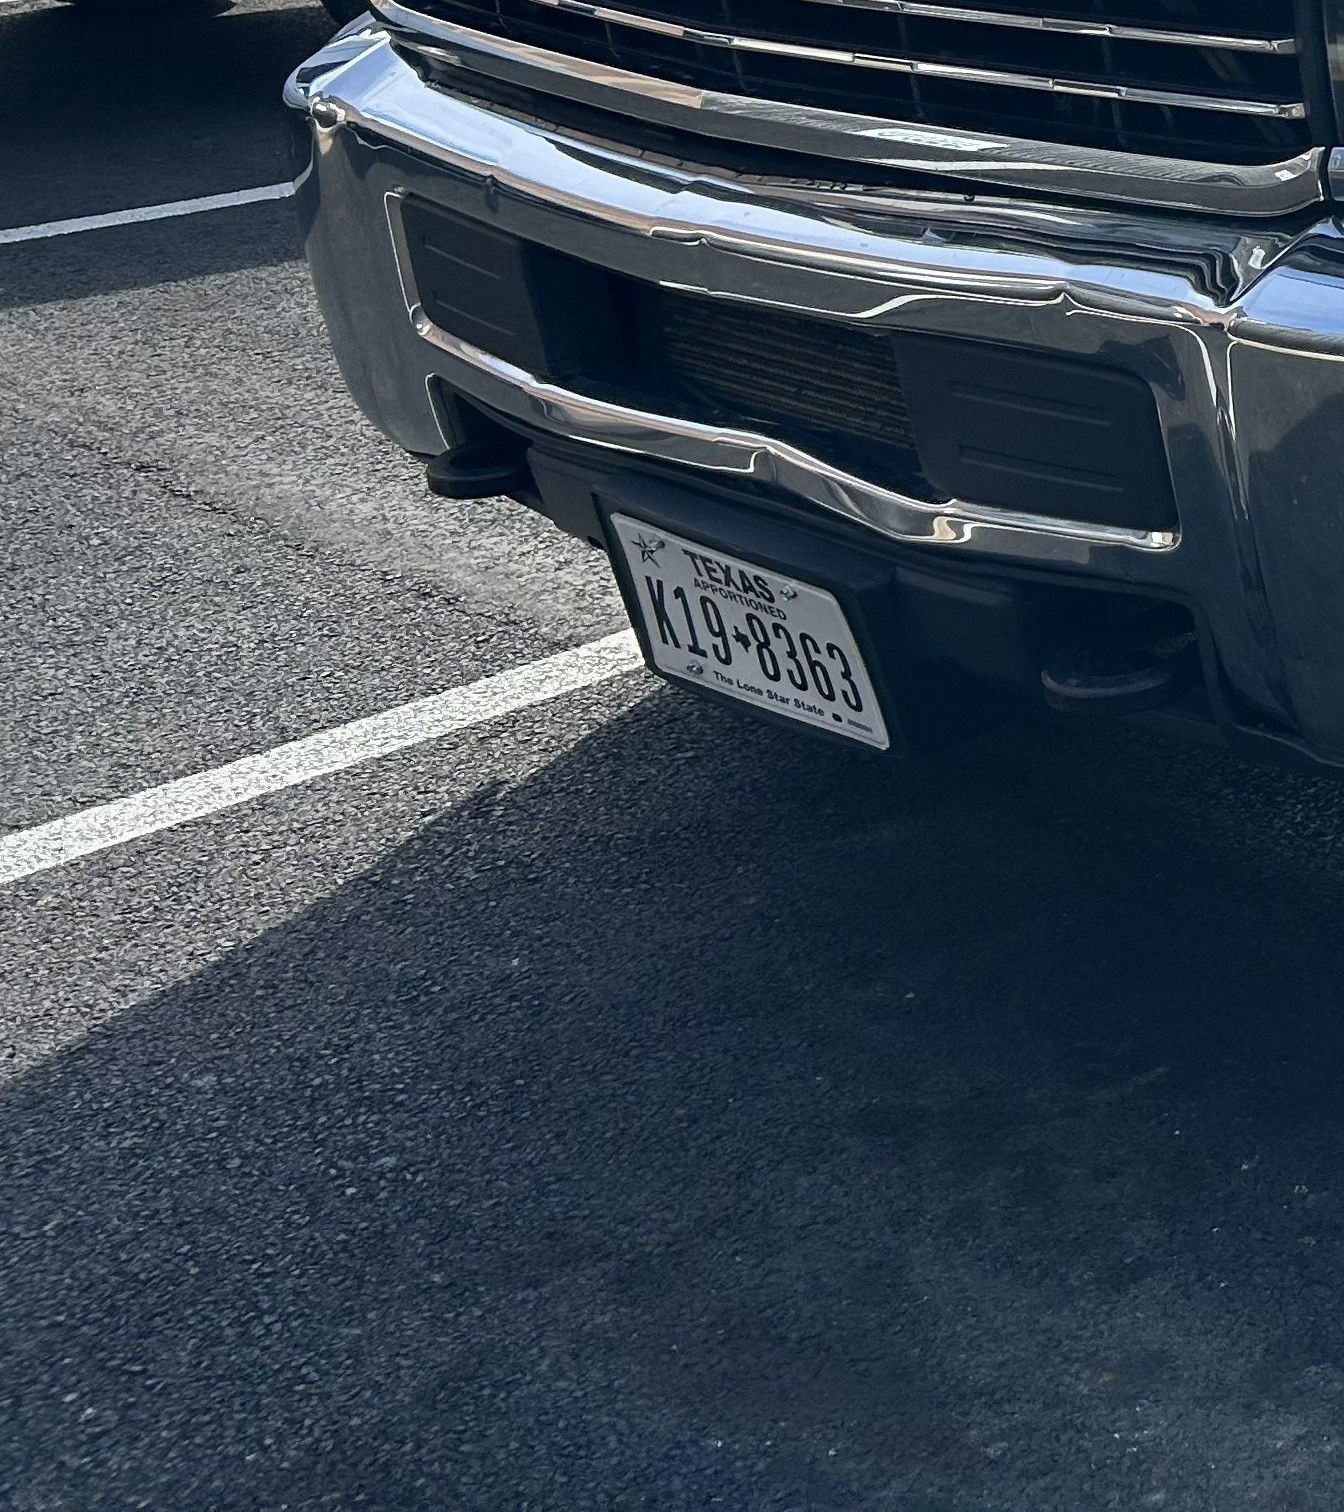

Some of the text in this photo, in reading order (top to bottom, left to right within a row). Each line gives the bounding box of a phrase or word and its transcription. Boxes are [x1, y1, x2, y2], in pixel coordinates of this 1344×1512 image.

[682, 548, 776, 604] TEXAS
[693, 576, 787, 621] APPORTIONED
[713, 670, 825, 717] The Lone Star State
